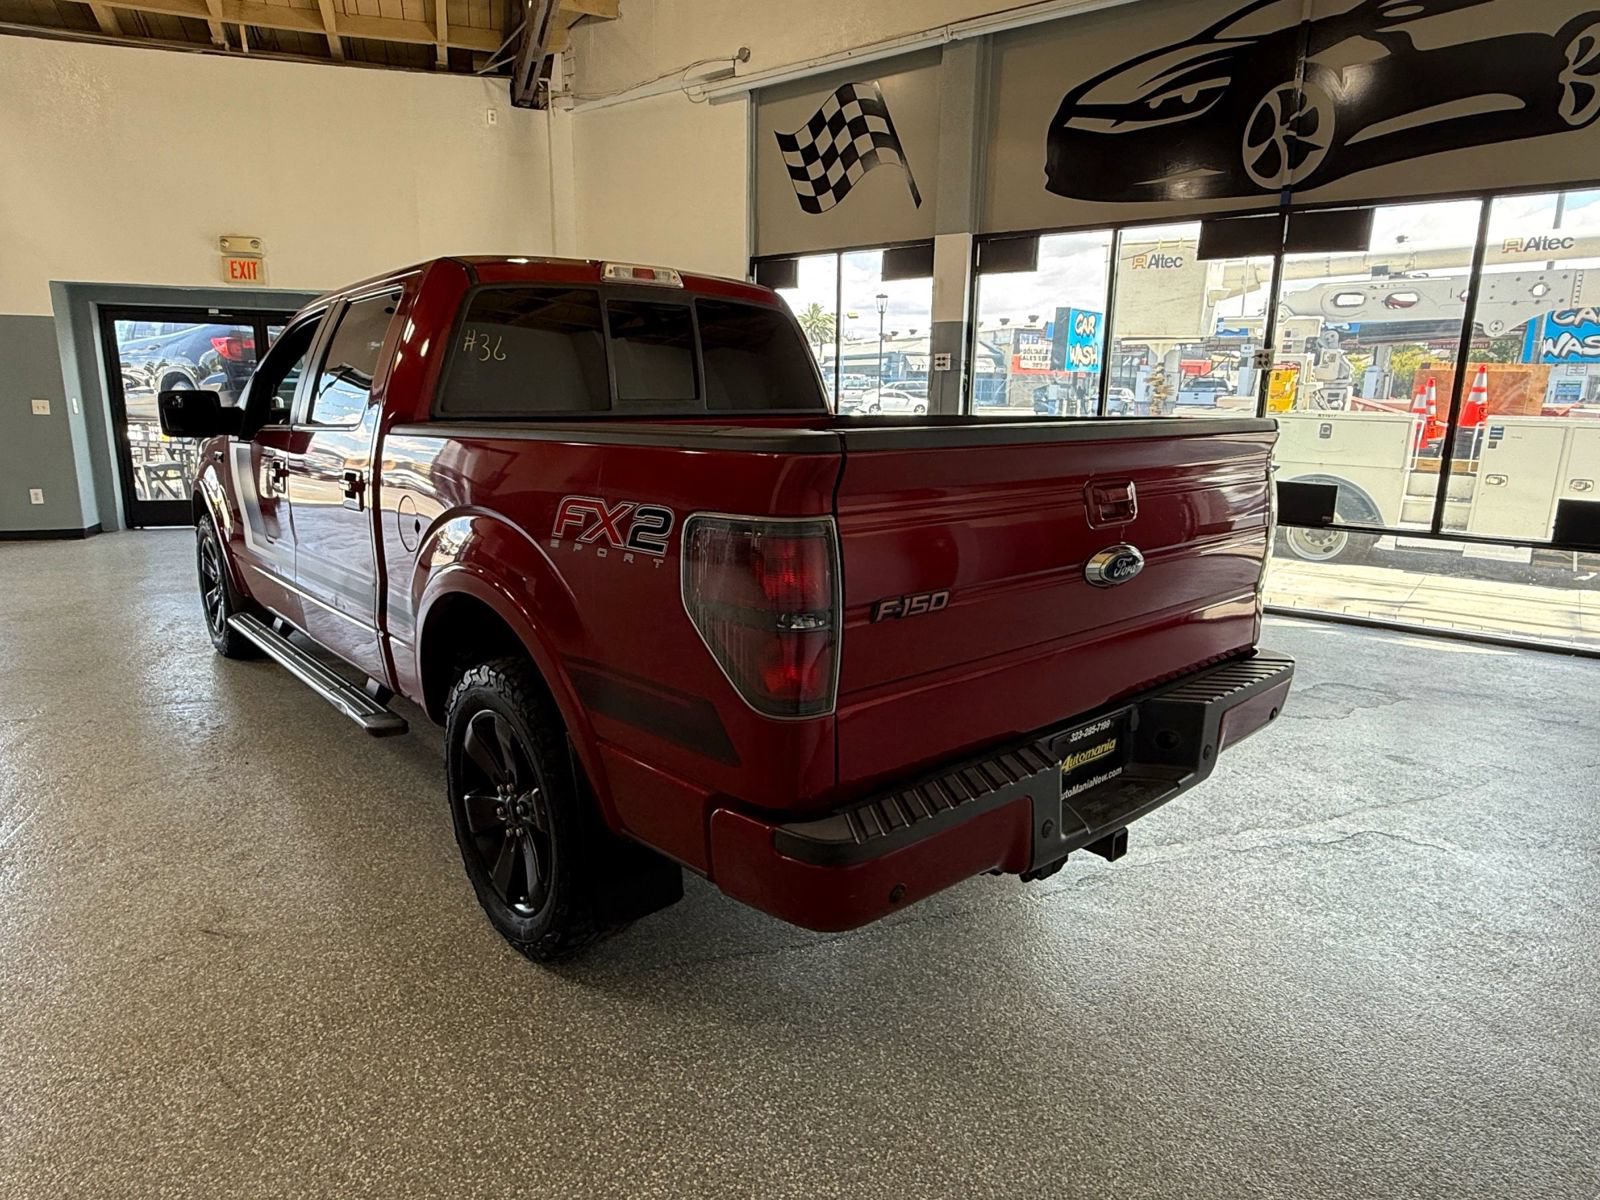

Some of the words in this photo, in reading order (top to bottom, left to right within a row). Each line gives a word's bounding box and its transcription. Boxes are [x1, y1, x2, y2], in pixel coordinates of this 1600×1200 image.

[1523, 236, 1575, 252] Altec
[229, 259, 258, 280] EXIT
[1147, 254, 1184, 269] Altec
[1075, 312, 1096, 337] CAR
[1552, 307, 1600, 328] CA
[463, 329, 507, 362] #36
[1069, 342, 1099, 368] WASH
[551, 495, 676, 558] FX2
[550, 539, 664, 569] SPORT
[1113, 556, 1139, 577] Ford
[876, 591, 950, 622] F-150
[1060, 738, 1117, 773] Automania
[1060, 766, 1122, 801] utoManiaNow.com
